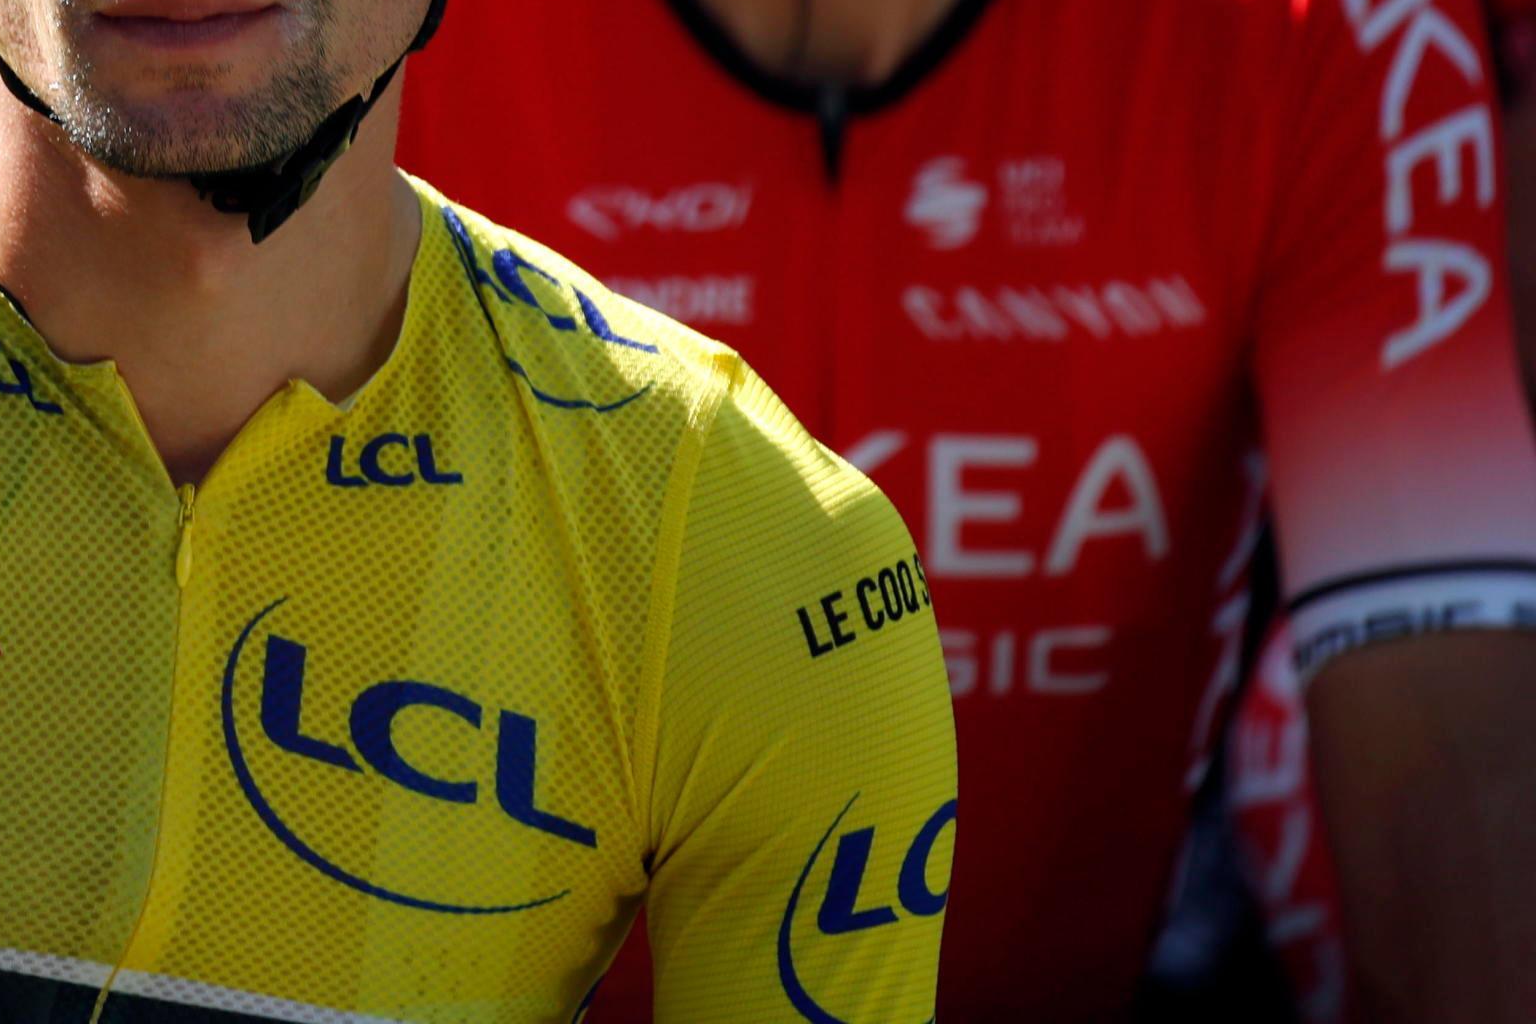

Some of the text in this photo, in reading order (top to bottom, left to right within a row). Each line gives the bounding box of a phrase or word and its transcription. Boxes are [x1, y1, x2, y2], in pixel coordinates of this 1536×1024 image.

[900, 274, 1207, 341] CANYON
[326, 433, 463, 487] LCL
[796, 590, 857, 659] LE
[856, 559, 920, 631] COQ
[263, 634, 598, 849] LCL
